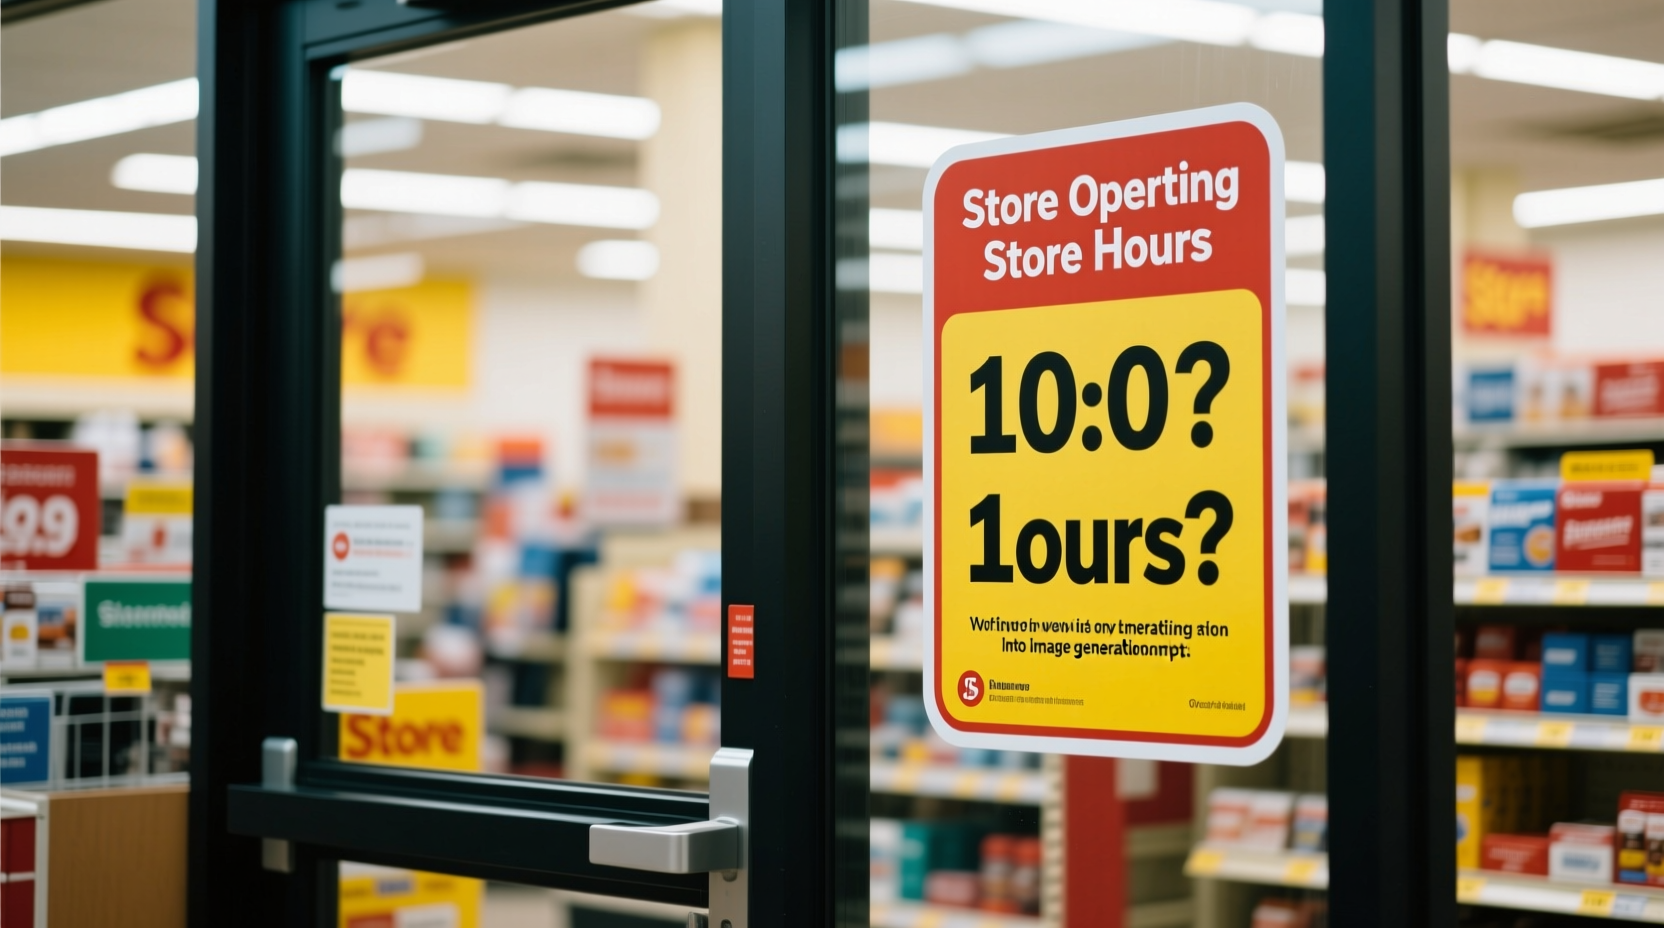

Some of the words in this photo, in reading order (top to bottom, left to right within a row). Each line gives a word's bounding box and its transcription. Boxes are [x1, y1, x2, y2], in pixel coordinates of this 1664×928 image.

[962, 187, 1059, 229] Store
[1068, 160, 1239, 224] Operting
[983, 240, 1083, 281] Store
[1094, 227, 1213, 271] Hours
[970, 340, 1231, 455] 10:0?
[969, 489, 1234, 586] 1ours?
[346, 712, 464, 759] Store
